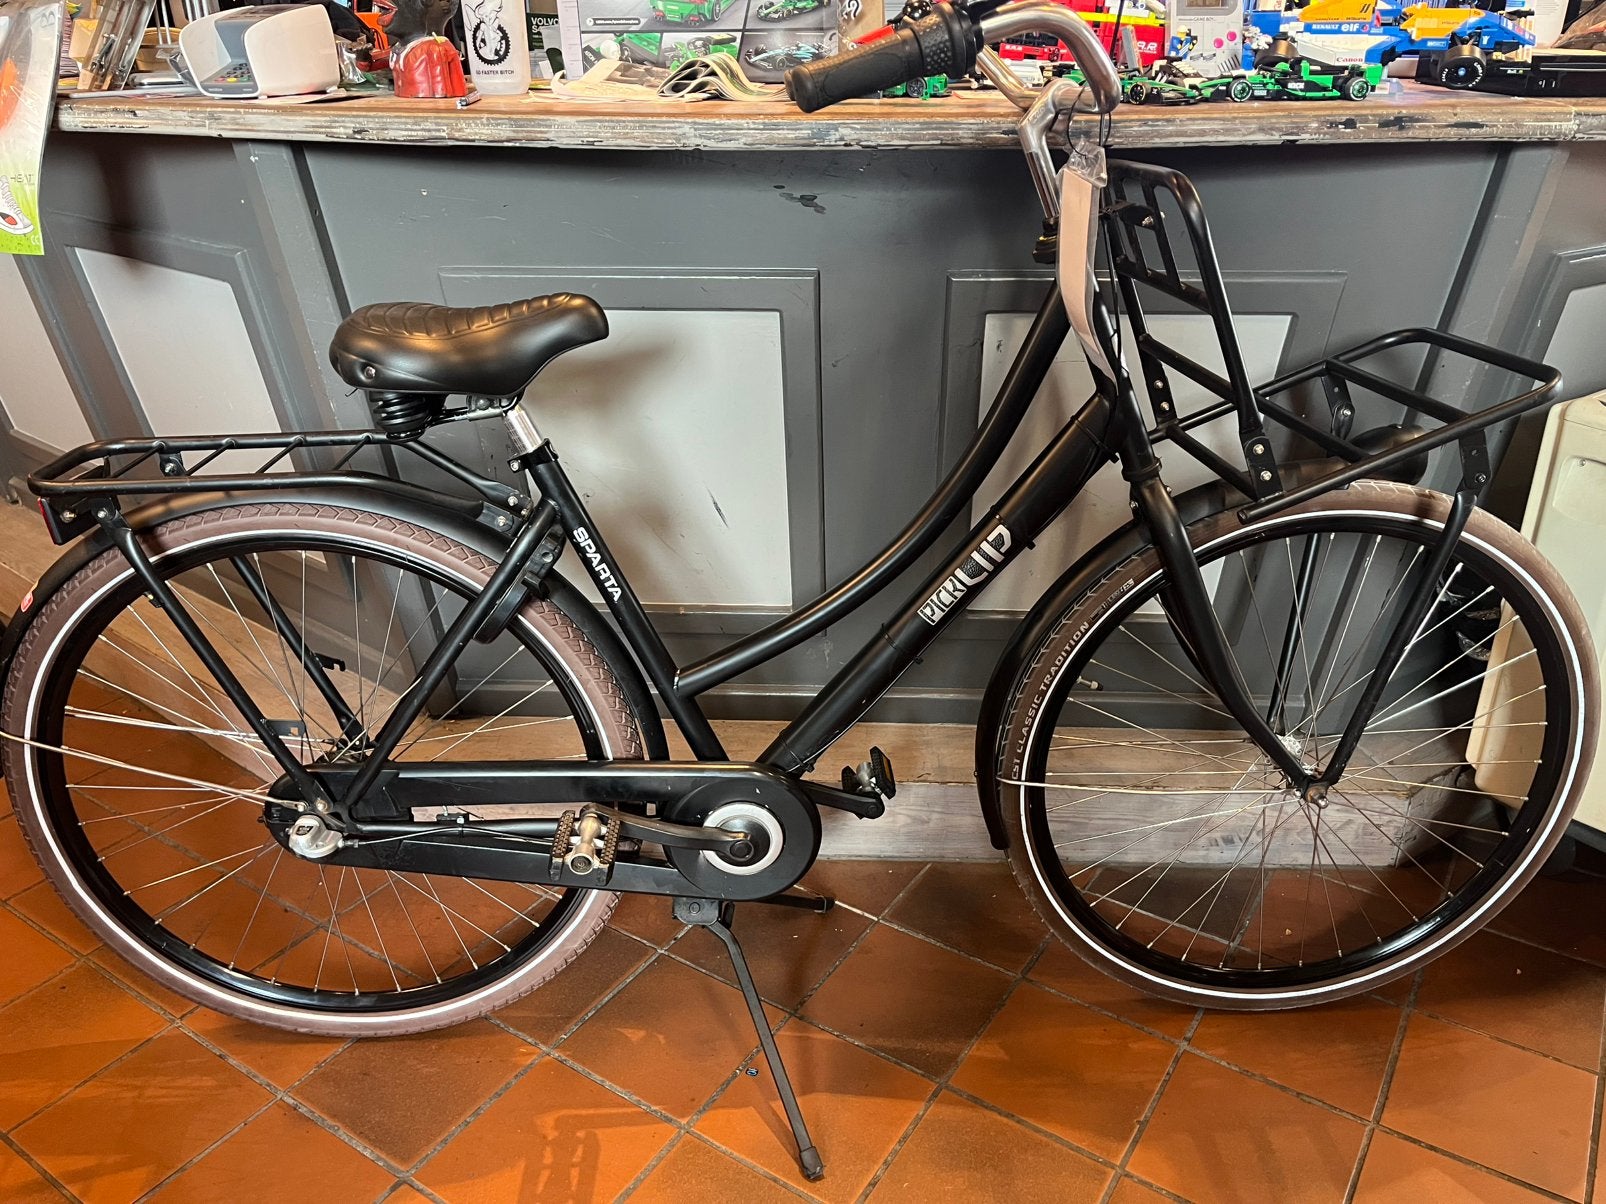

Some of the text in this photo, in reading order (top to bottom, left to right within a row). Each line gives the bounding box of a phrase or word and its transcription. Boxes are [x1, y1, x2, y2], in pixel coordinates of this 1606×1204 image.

[1341, 23, 1360, 32] elf
[573, 526, 622, 602] SPARTA
[918, 577, 967, 625] PICK
[1011, 620, 1090, 780] CST CLASSIC TRADITION
